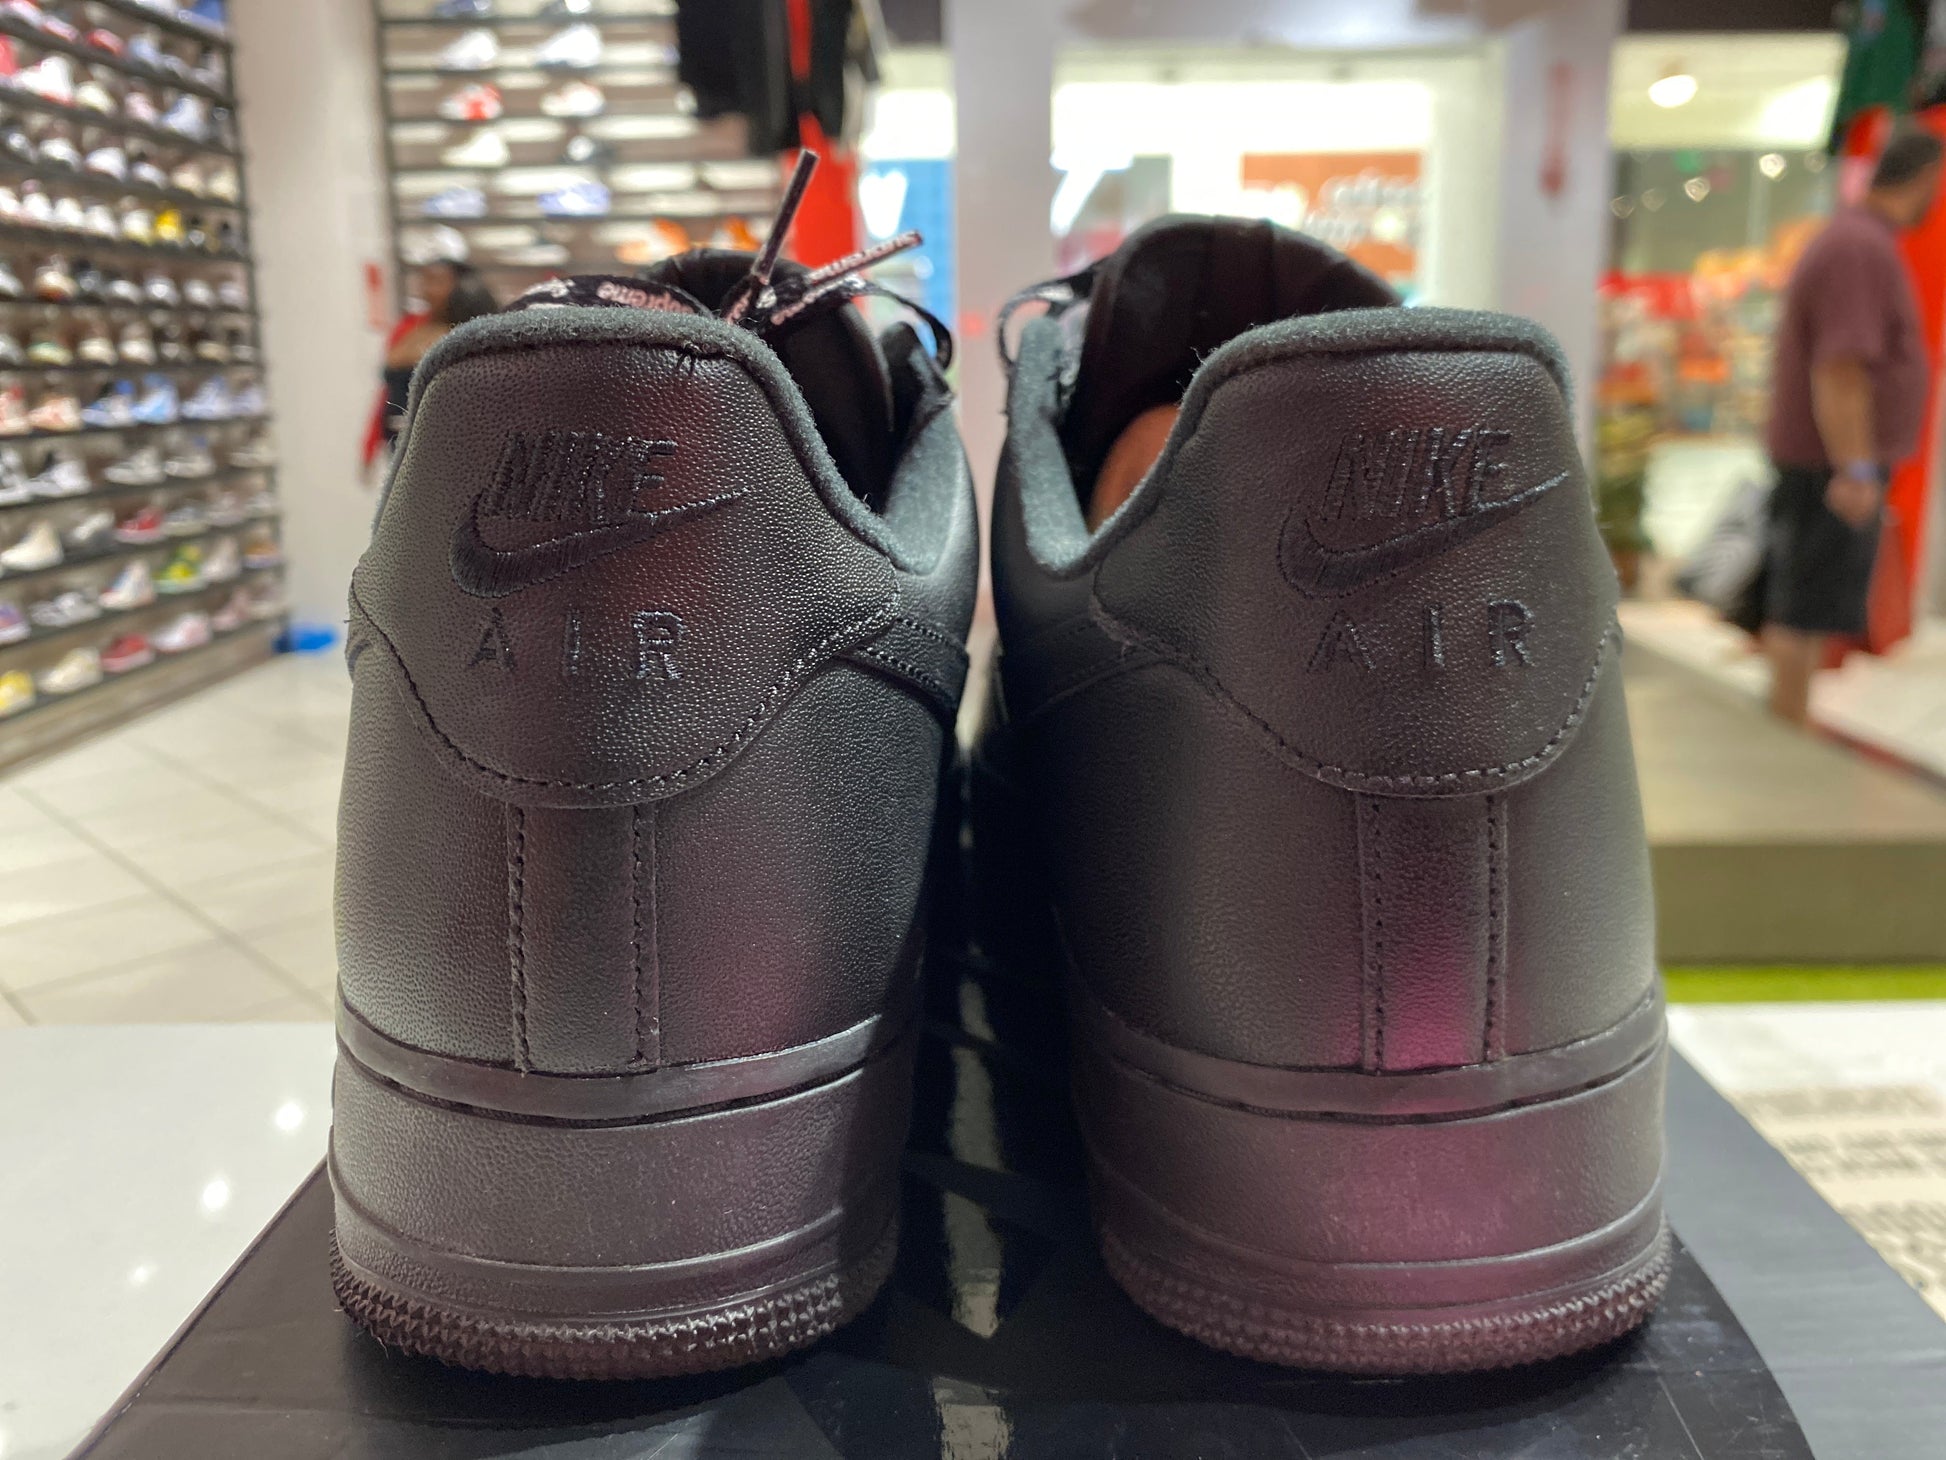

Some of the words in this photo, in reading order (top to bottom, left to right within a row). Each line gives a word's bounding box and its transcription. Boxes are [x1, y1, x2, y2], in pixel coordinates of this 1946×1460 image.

[480, 430, 678, 524] NIKE
[1320, 427, 1512, 521] NIKE
[467, 606, 686, 681] AIR
[1306, 598, 1536, 674] AIR
